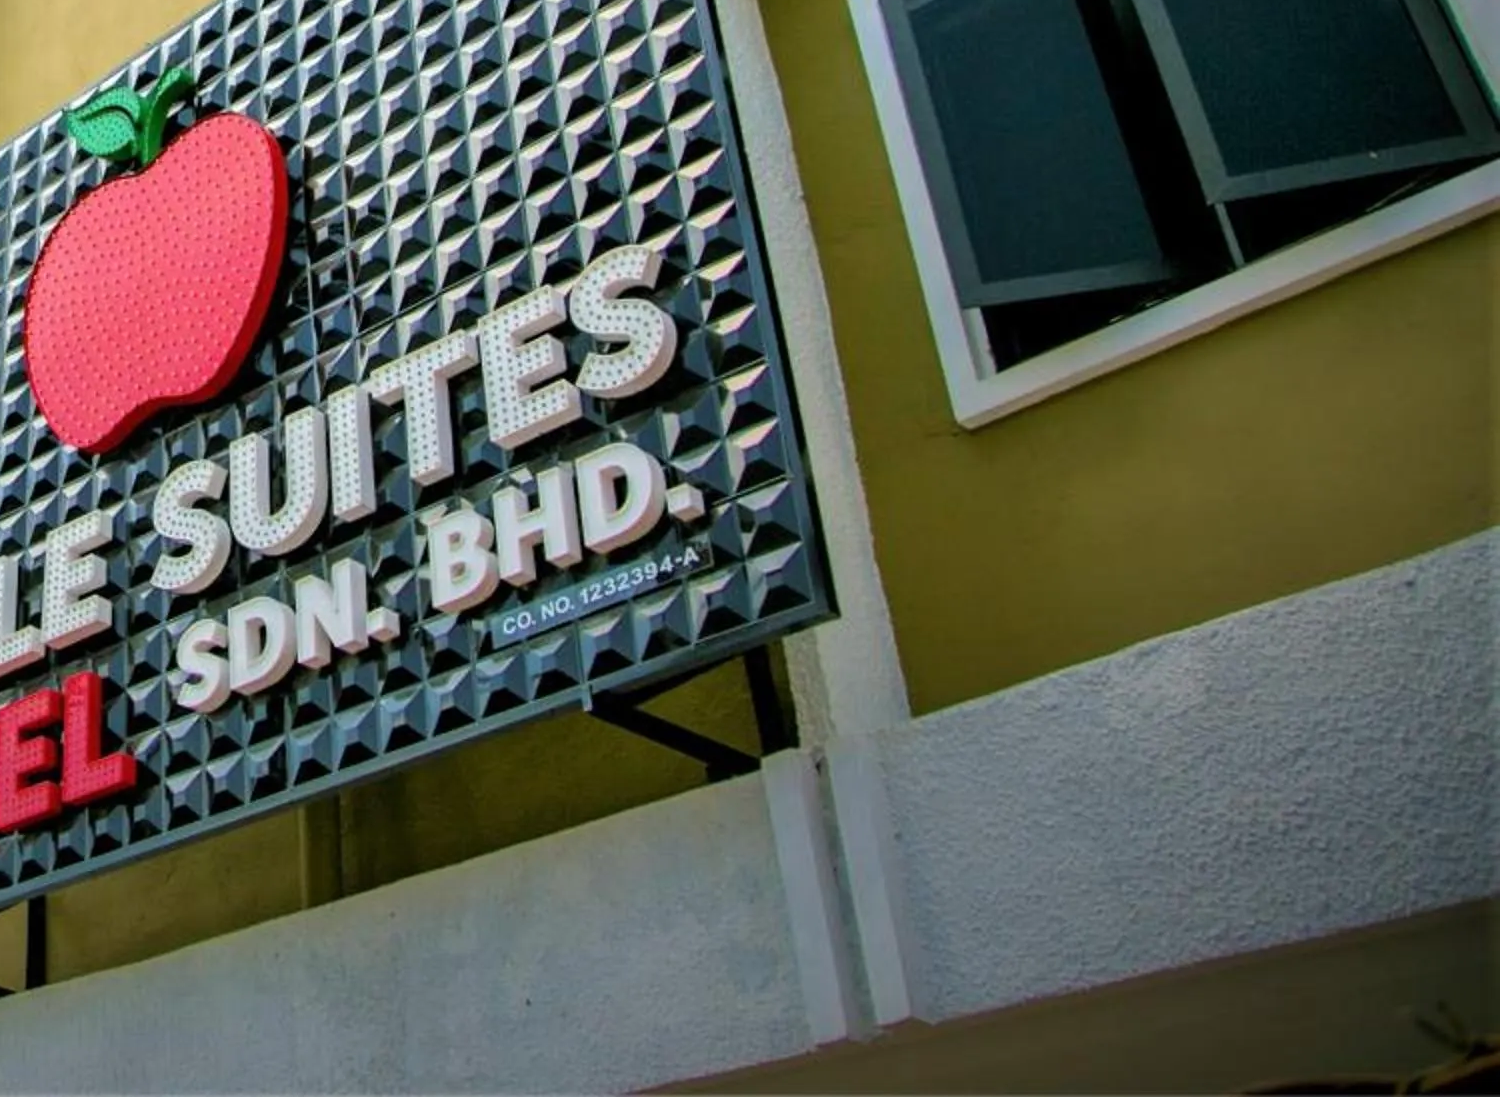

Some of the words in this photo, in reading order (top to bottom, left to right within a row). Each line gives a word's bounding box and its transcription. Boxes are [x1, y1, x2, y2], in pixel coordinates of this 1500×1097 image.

[150, 244, 678, 595] SUITES
[176, 559, 401, 713] SDN.
[428, 442, 706, 614] BHD.
[503, 614, 536, 634] CO.
[541, 598, 575, 621] NO.
[579, 546, 699, 603] 1232394-A
